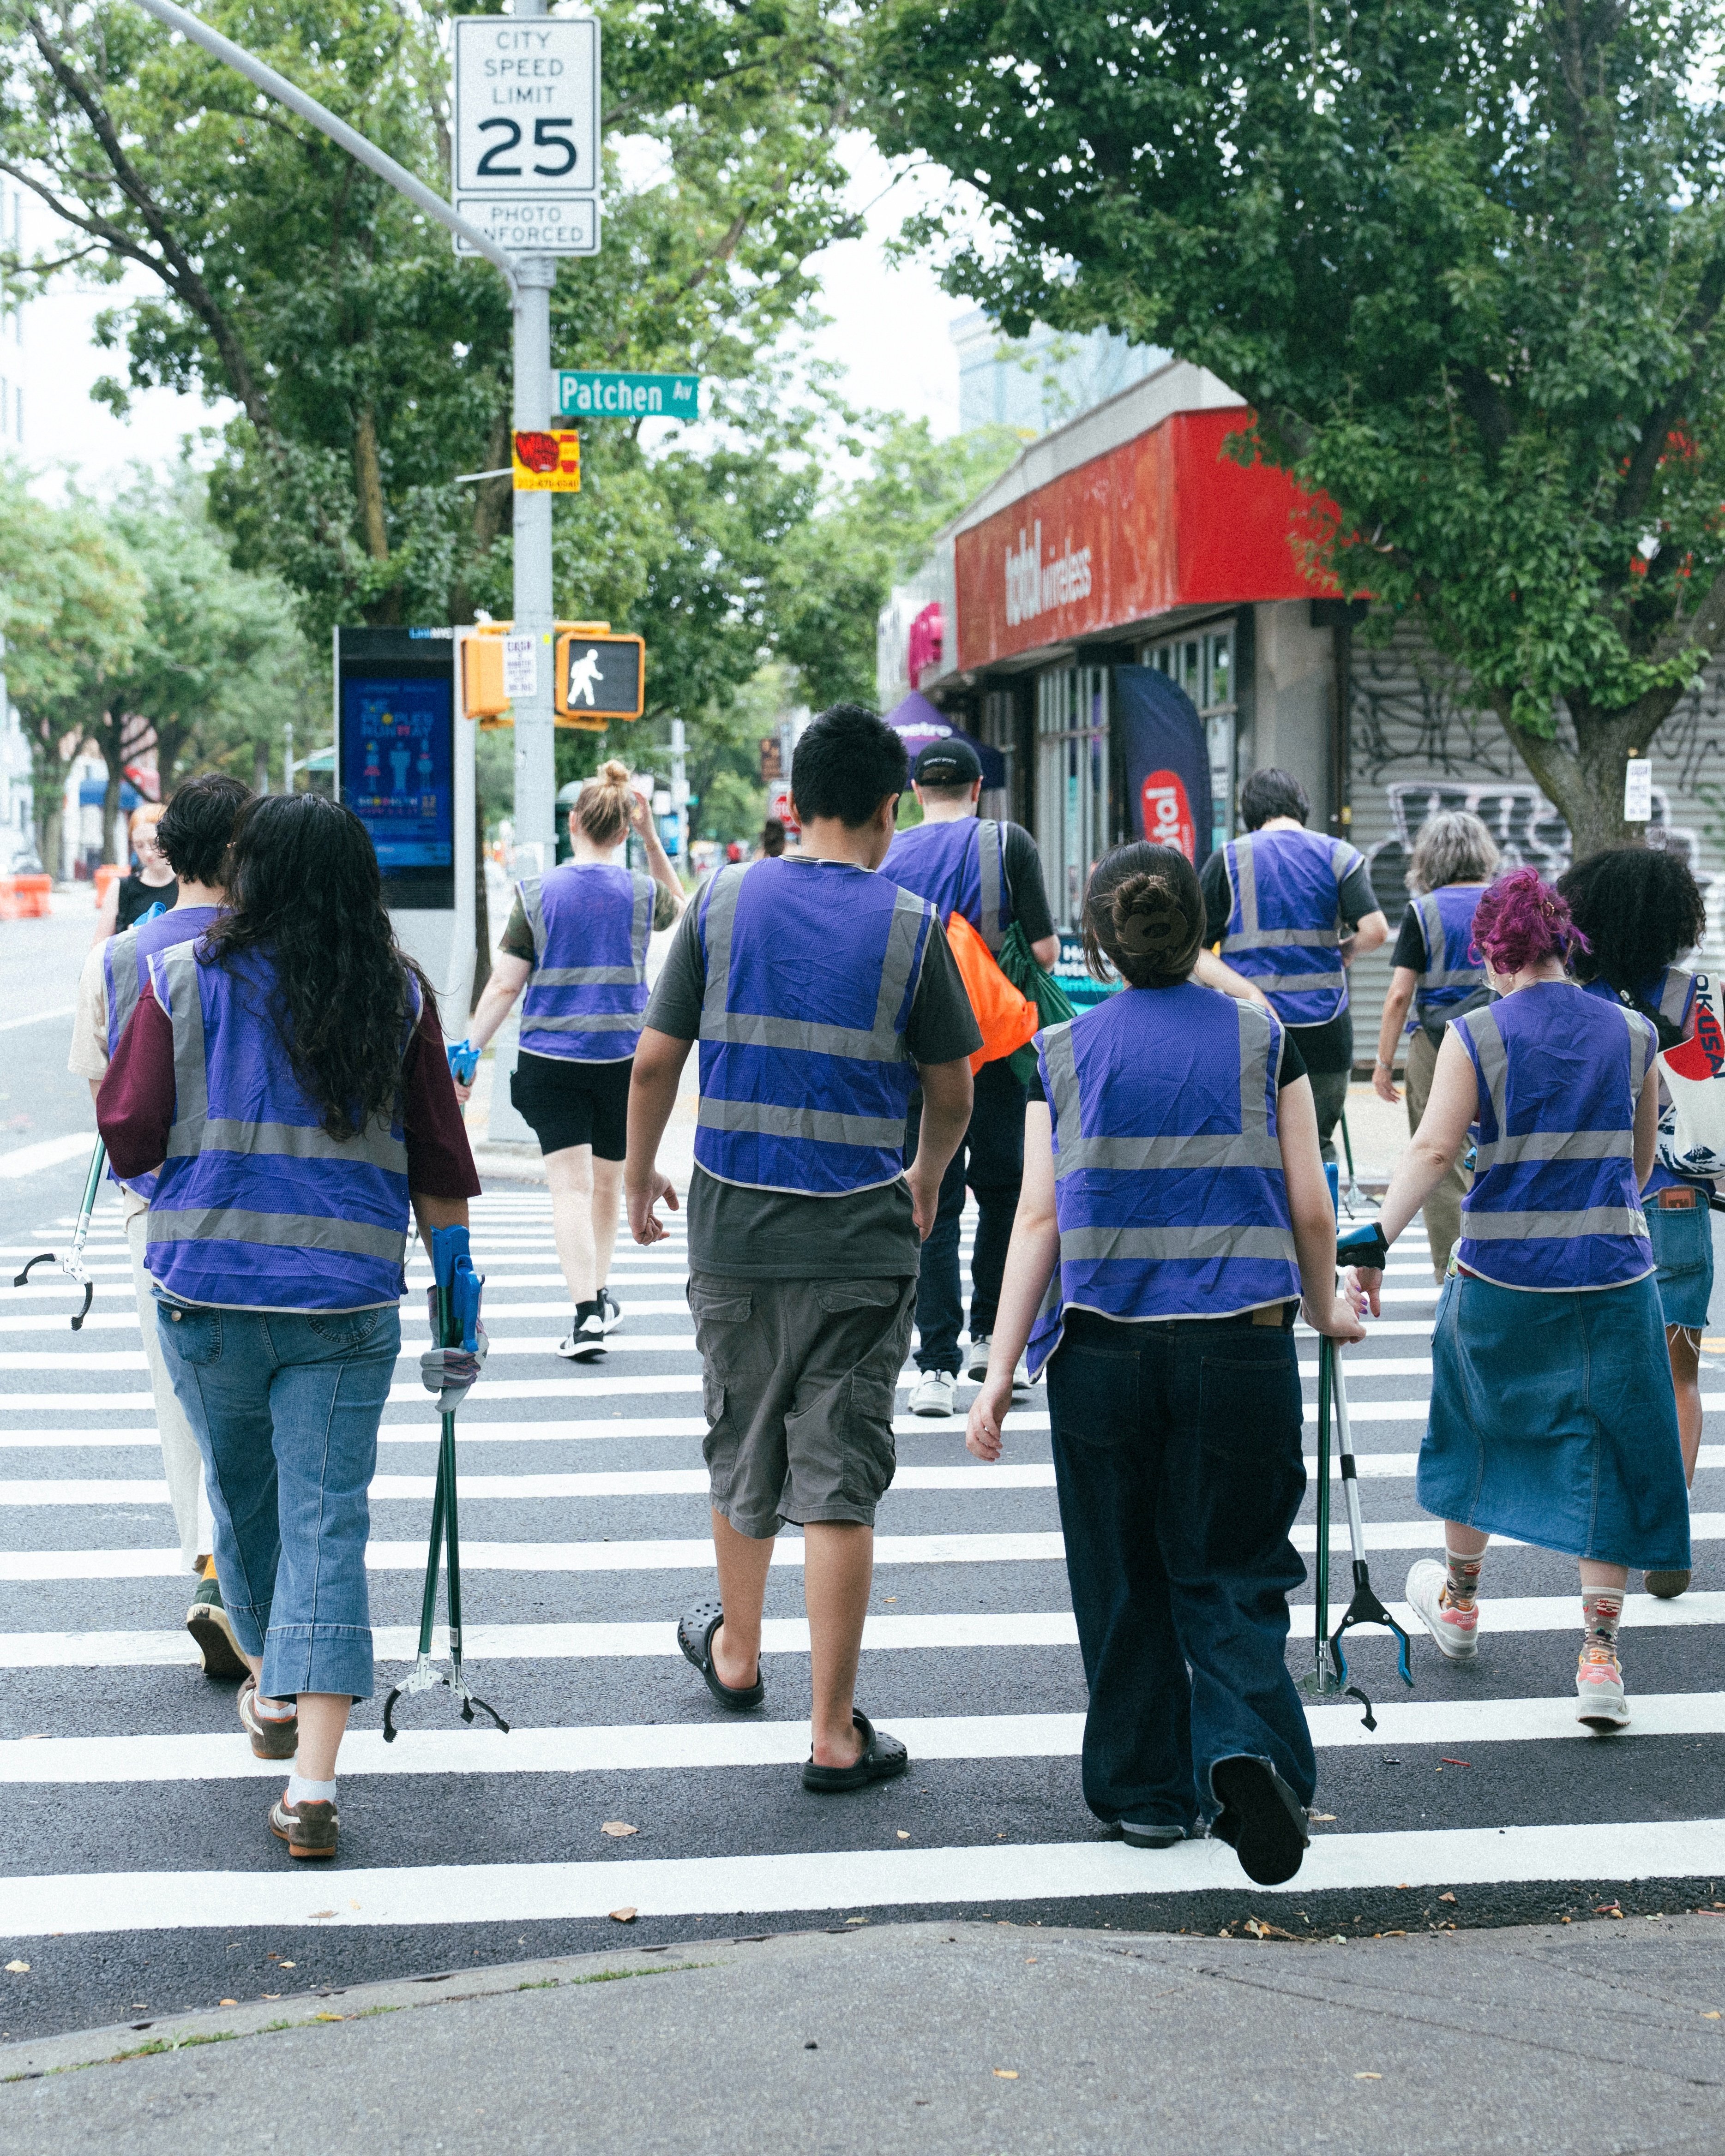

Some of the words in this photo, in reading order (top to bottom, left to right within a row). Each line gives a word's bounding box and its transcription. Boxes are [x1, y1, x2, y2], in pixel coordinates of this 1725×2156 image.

[497, 30, 552, 49] CITY
[484, 58, 565, 77] SPEED
[493, 86, 555, 104] LIMIT
[477, 118, 577, 176] 25
[492, 207, 561, 222] PHOTO
[484, 227, 583, 242] NFORCED
[562, 377, 662, 412] Patchen
[673, 380, 692, 401] Av
[1696, 974, 1725, 1079] OKUSAI
